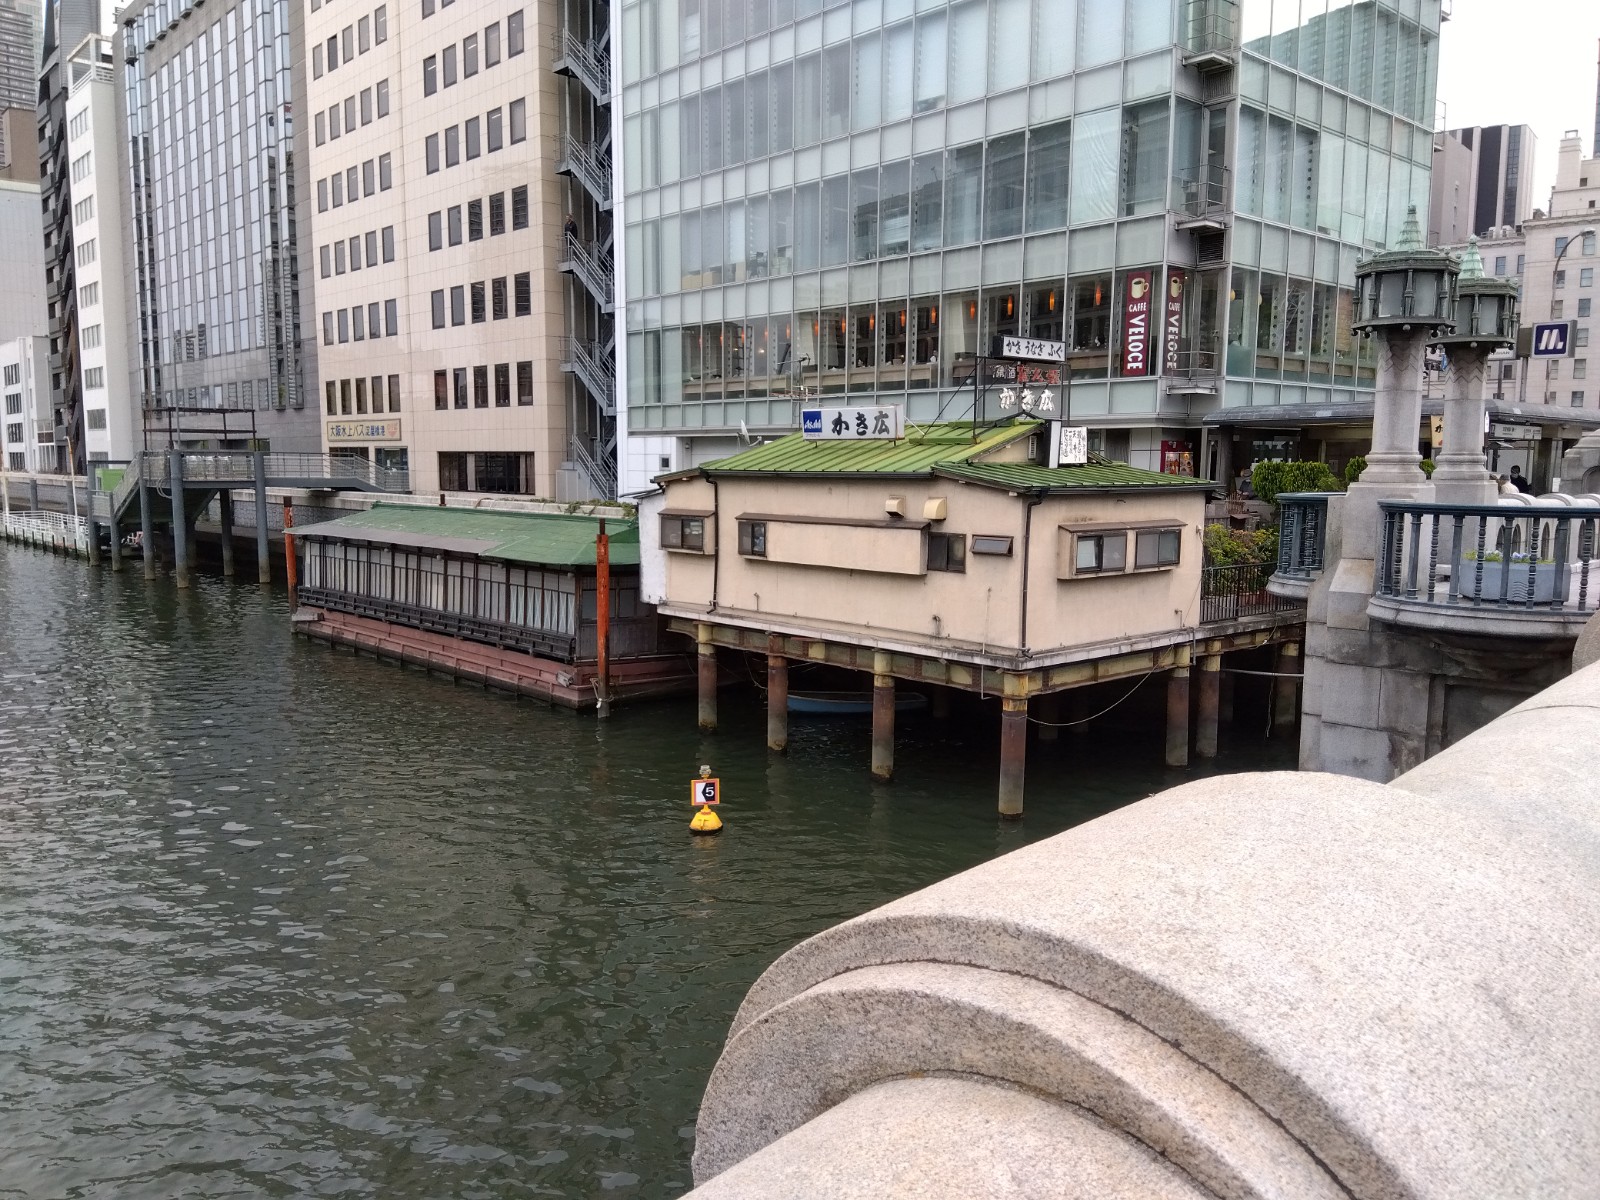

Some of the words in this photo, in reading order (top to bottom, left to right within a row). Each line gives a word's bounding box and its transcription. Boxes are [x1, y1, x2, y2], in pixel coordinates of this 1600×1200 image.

[1128, 302, 1147, 313] CAFFE
[1127, 313, 1146, 370] VELOCE
[1167, 314, 1180, 369] VELOCE
[832, 410, 890, 436] かき広
[705, 786, 715, 797] 5
